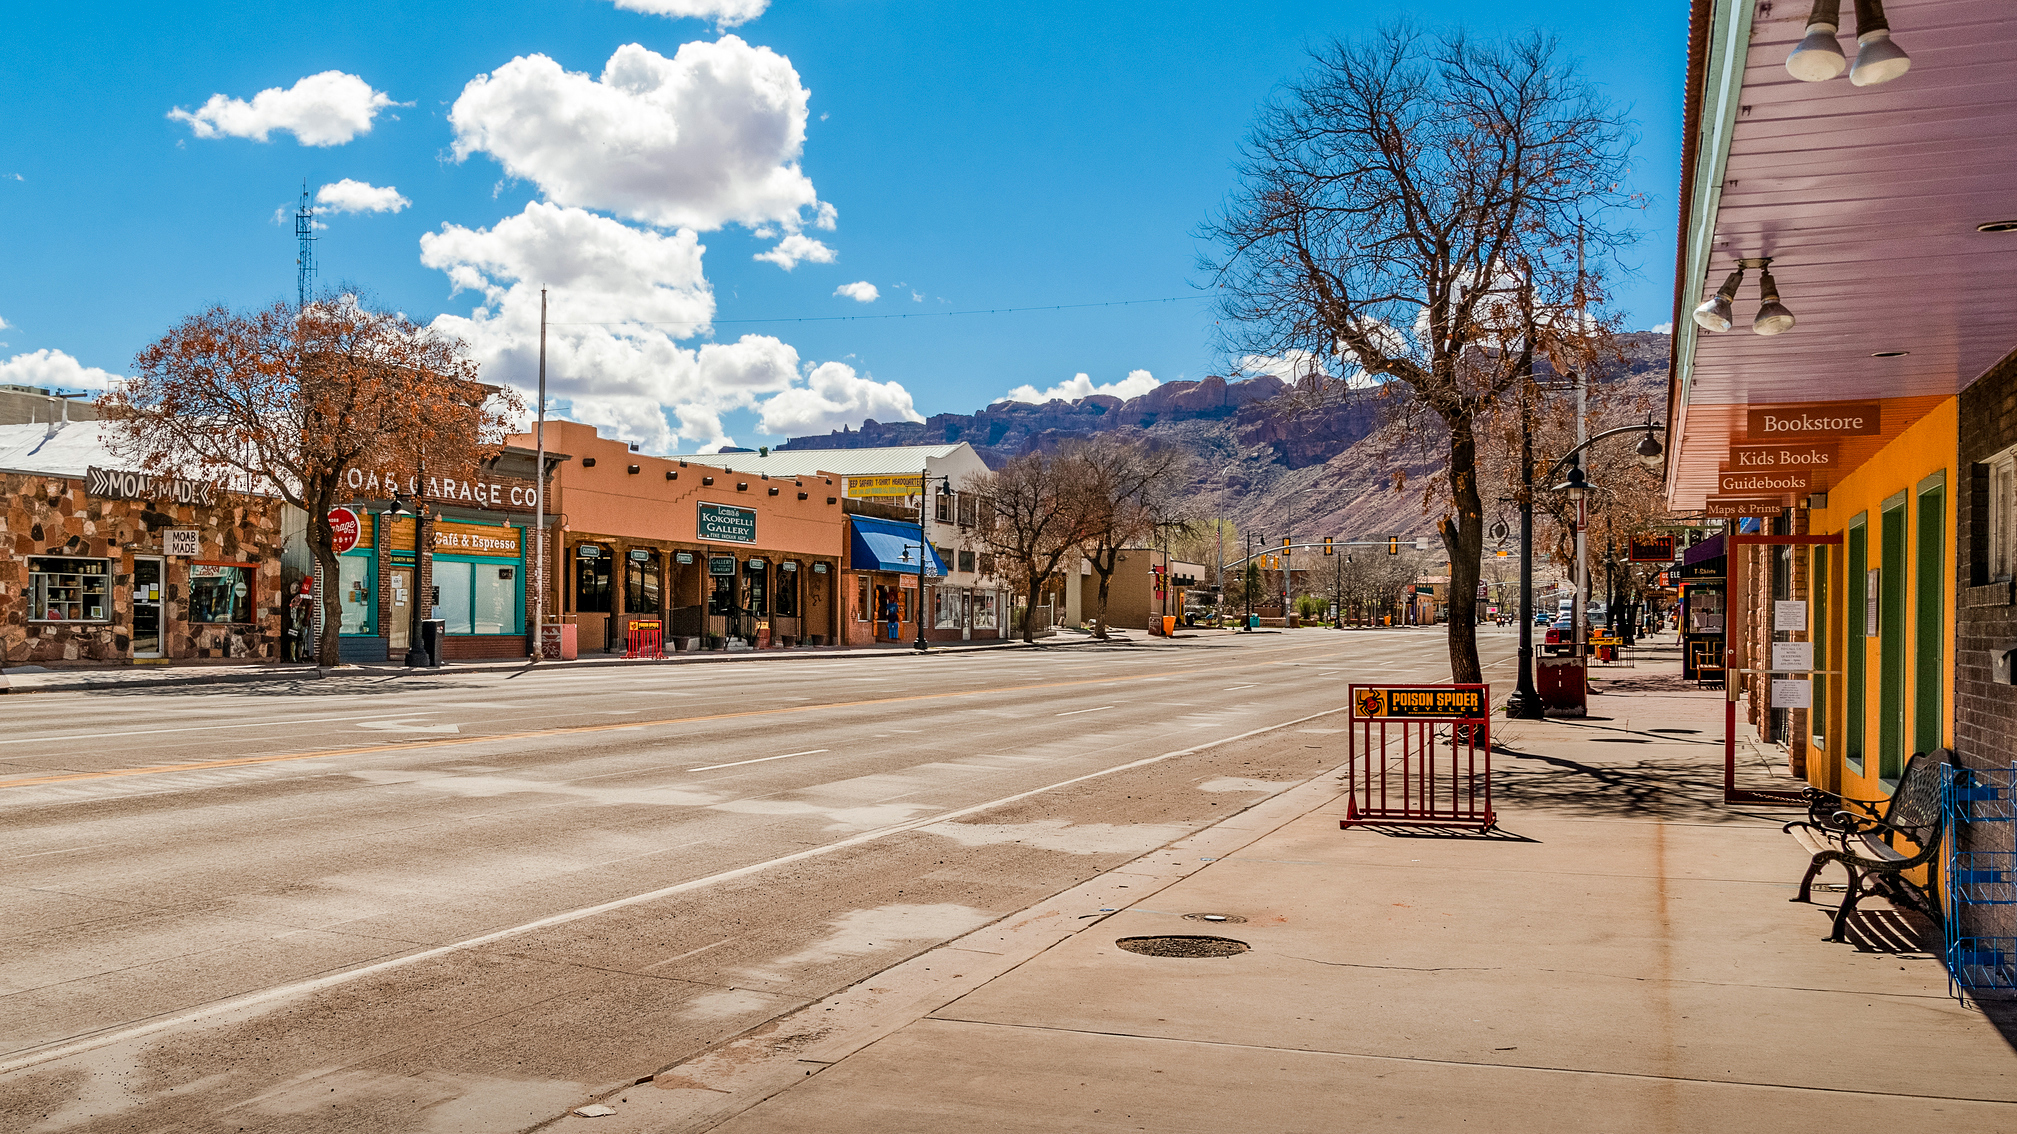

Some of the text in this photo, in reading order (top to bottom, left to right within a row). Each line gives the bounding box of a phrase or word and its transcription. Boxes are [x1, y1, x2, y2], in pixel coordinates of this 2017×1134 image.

[1763, 413, 1863, 432] Bookstore
[1738, 449, 1829, 466] Kids Books
[108, 472, 200, 504] MOAB MADE
[340, 467, 537, 507] OAB GARAGE CO
[849, 477, 924, 489] JEEP SAFARI T-SHIRT HEADQUARTER
[1722, 475, 1806, 490] Guidebooks
[1708, 503, 1781, 517] Maps & Prints
[702, 512, 753, 526] KOKOPELLI
[706, 522, 749, 535] GALLERY
[172, 530, 196, 543] MOAB
[434, 531, 516, 551] Café & Espresso
[172, 542, 196, 554] MADE
[1392, 692, 1479, 706] POISON SPIDER
